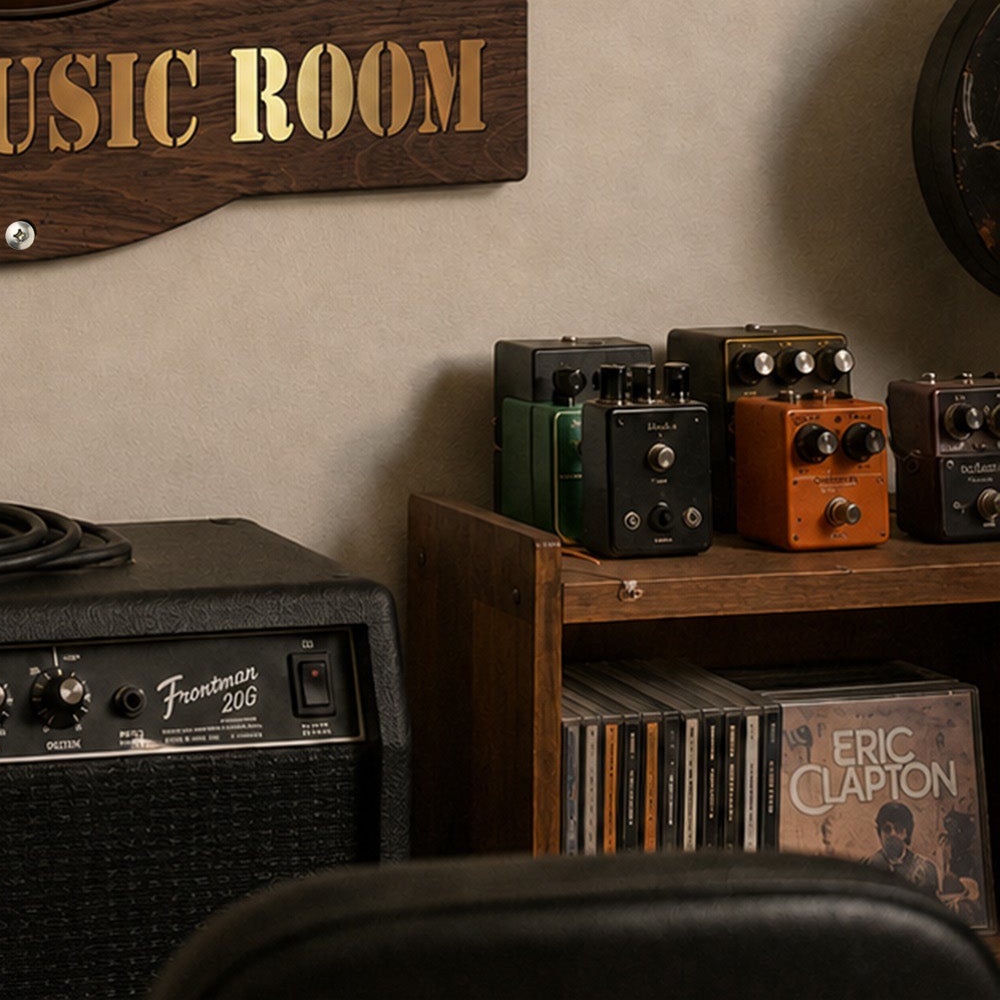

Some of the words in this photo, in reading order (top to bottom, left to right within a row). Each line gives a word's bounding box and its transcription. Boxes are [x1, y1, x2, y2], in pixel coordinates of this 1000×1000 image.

[230, 39, 487, 142] ROOM
[156, 666, 259, 720] Frontman
[221, 685, 258, 714] 20G
[833, 726, 916, 768] ERIC
[789, 760, 960, 816] CLAPTON
